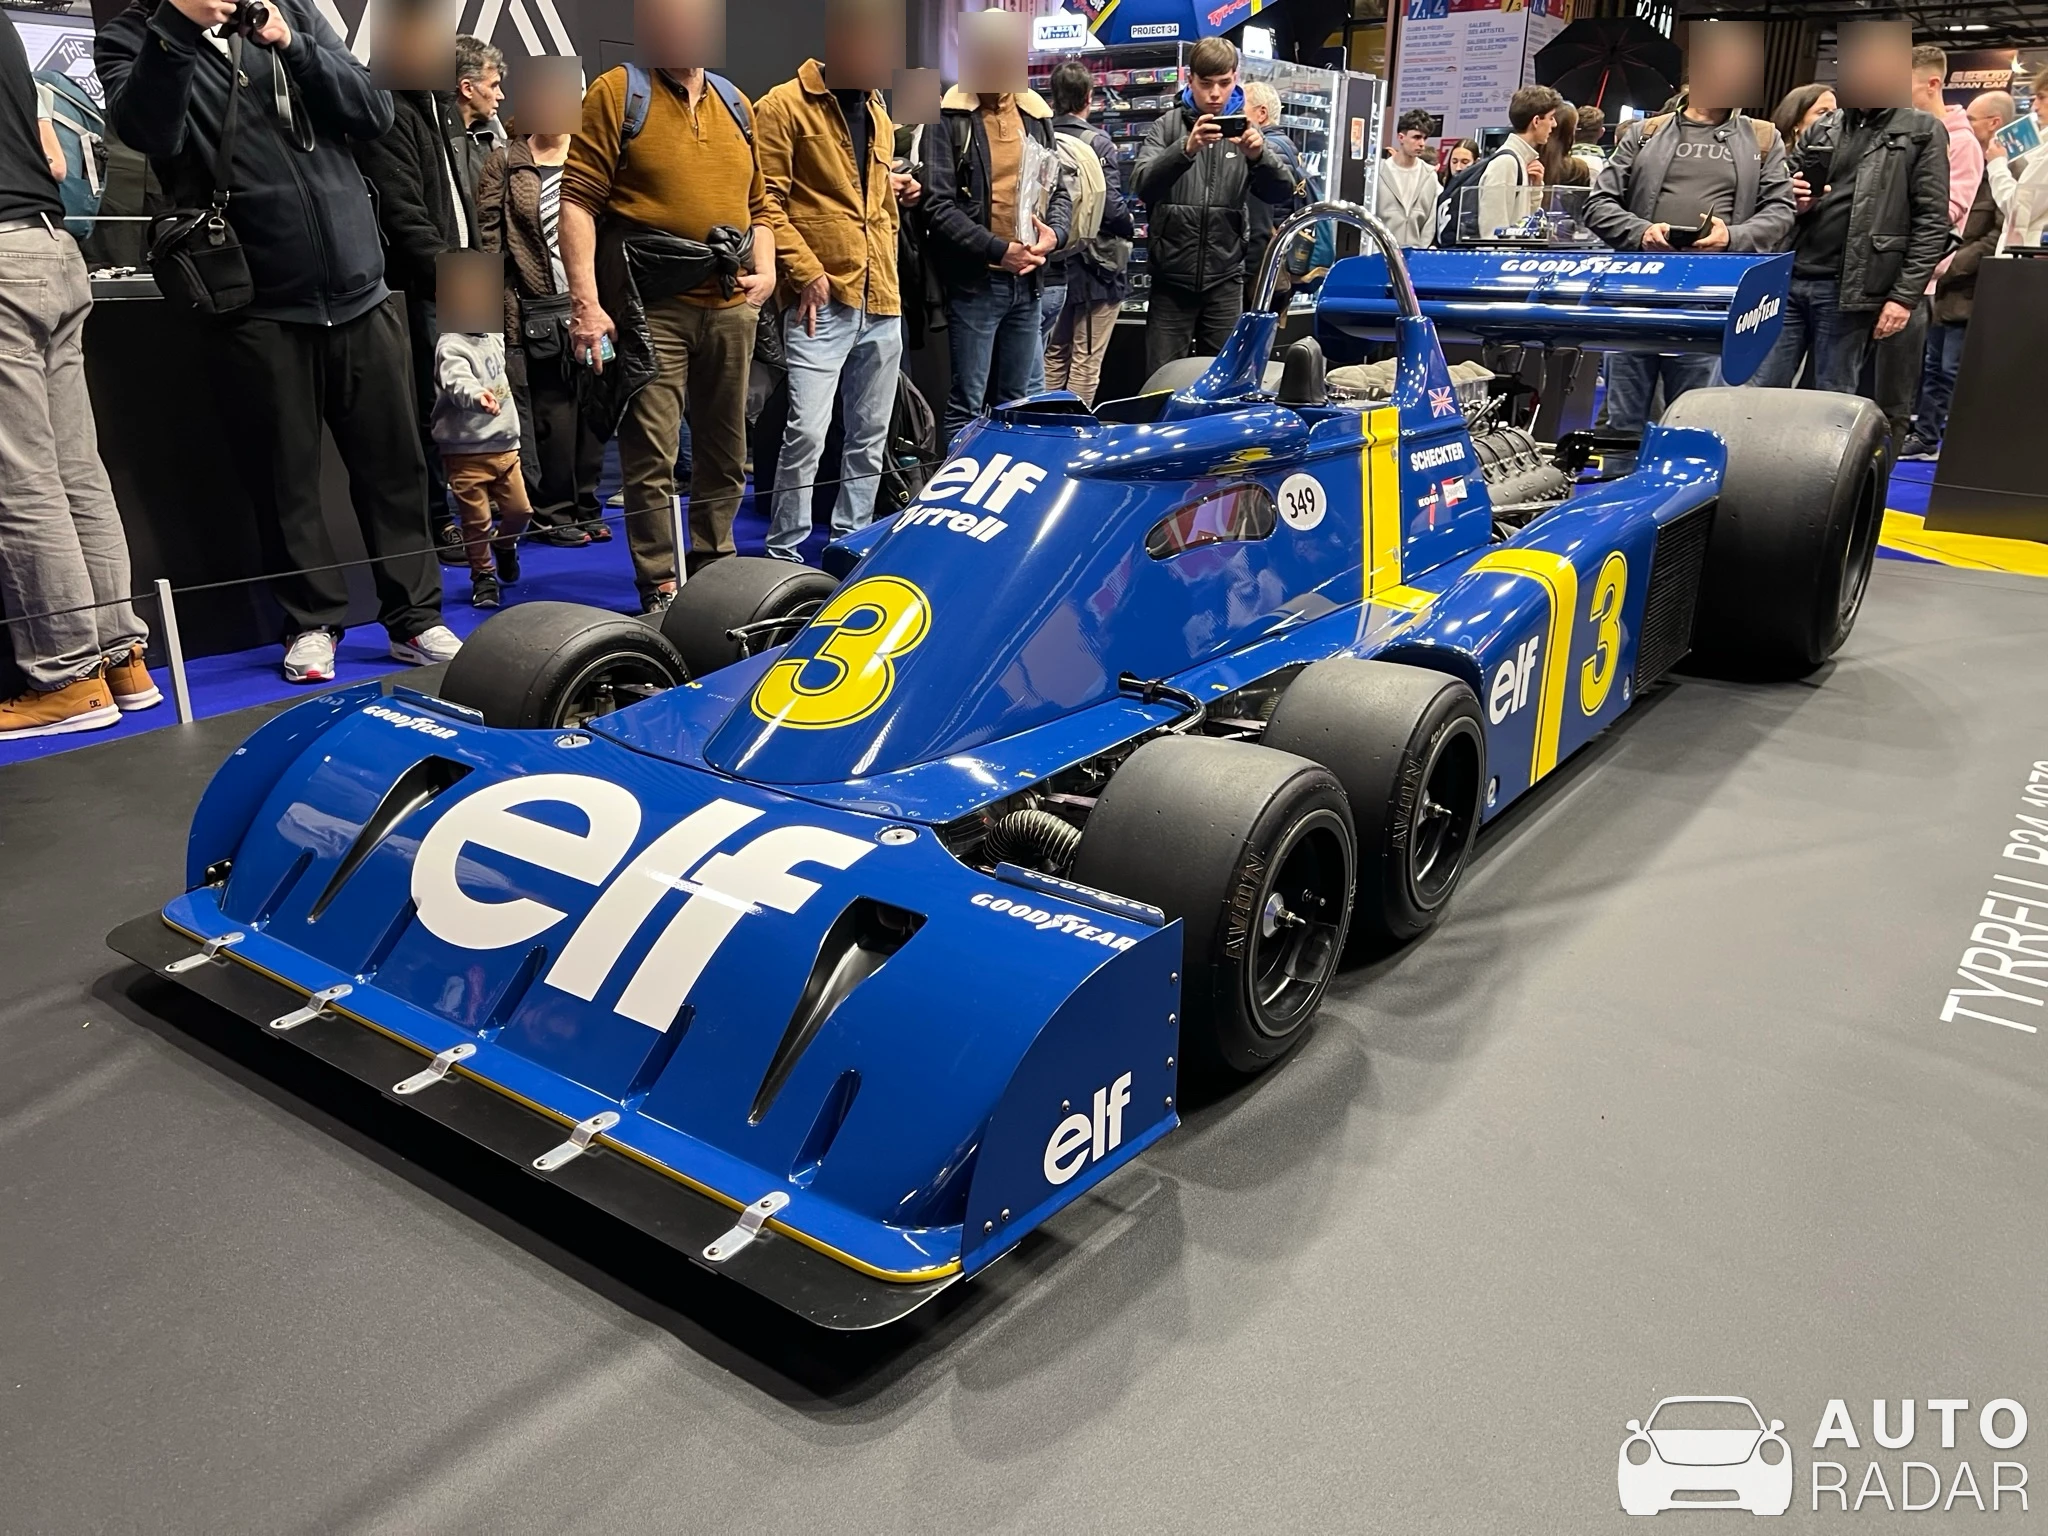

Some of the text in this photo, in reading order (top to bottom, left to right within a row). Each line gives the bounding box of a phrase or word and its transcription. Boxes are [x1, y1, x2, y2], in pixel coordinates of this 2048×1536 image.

[59, 40, 91, 64] THE
[1132, 24, 1178, 35] PROJECT 34
[1675, 142, 1734, 162] OTUS
[1500, 257, 1665, 277] GOODYEAR
[1735, 294, 1781, 335] GOODYEAR
[1410, 442, 1466, 472] SCHECKTER
[918, 453, 1048, 514] elf
[1286, 487, 1315, 519] 349
[751, 574, 932, 730] 3
[1580, 550, 1628, 717] 3
[1489, 635, 1539, 725] elf
[362, 705, 459, 739] GOODYEAR
[411, 773, 878, 1034] elf
[970, 893, 1139, 952] GOODYEAR
[1225, 851, 1267, 960] AVON
[1044, 1071, 1132, 1185] elf
